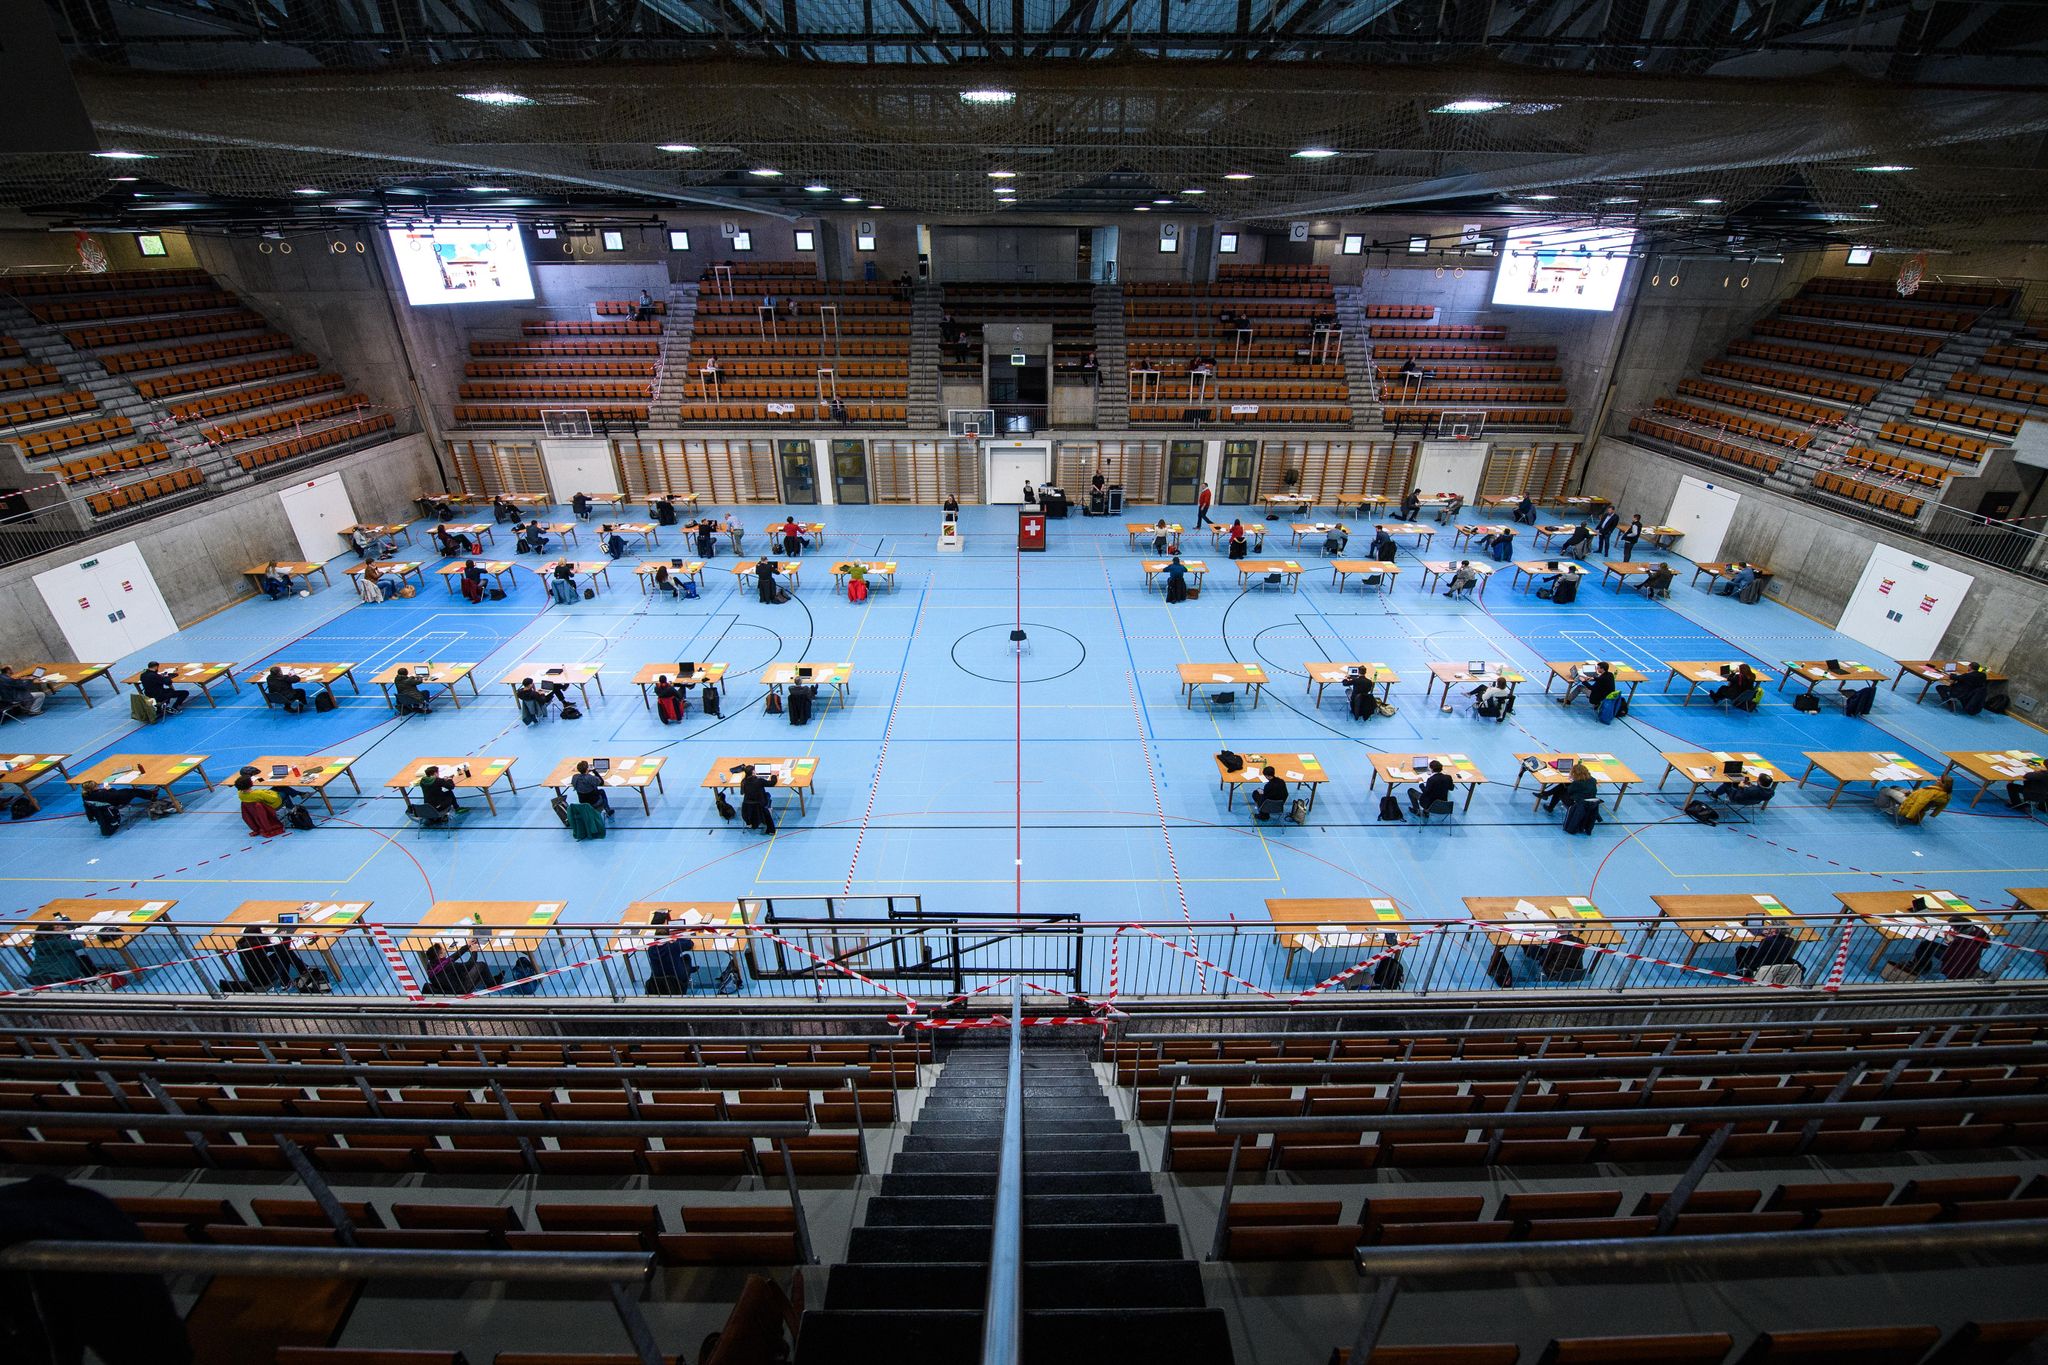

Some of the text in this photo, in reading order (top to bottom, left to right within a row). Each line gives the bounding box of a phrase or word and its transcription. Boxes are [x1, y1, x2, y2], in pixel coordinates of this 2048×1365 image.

[725, 222, 735, 233] D
[862, 222, 871, 234] D
[1164, 224, 1174, 236] C
[1295, 225, 1304, 237] C
[1466, 228, 1476, 240] C
